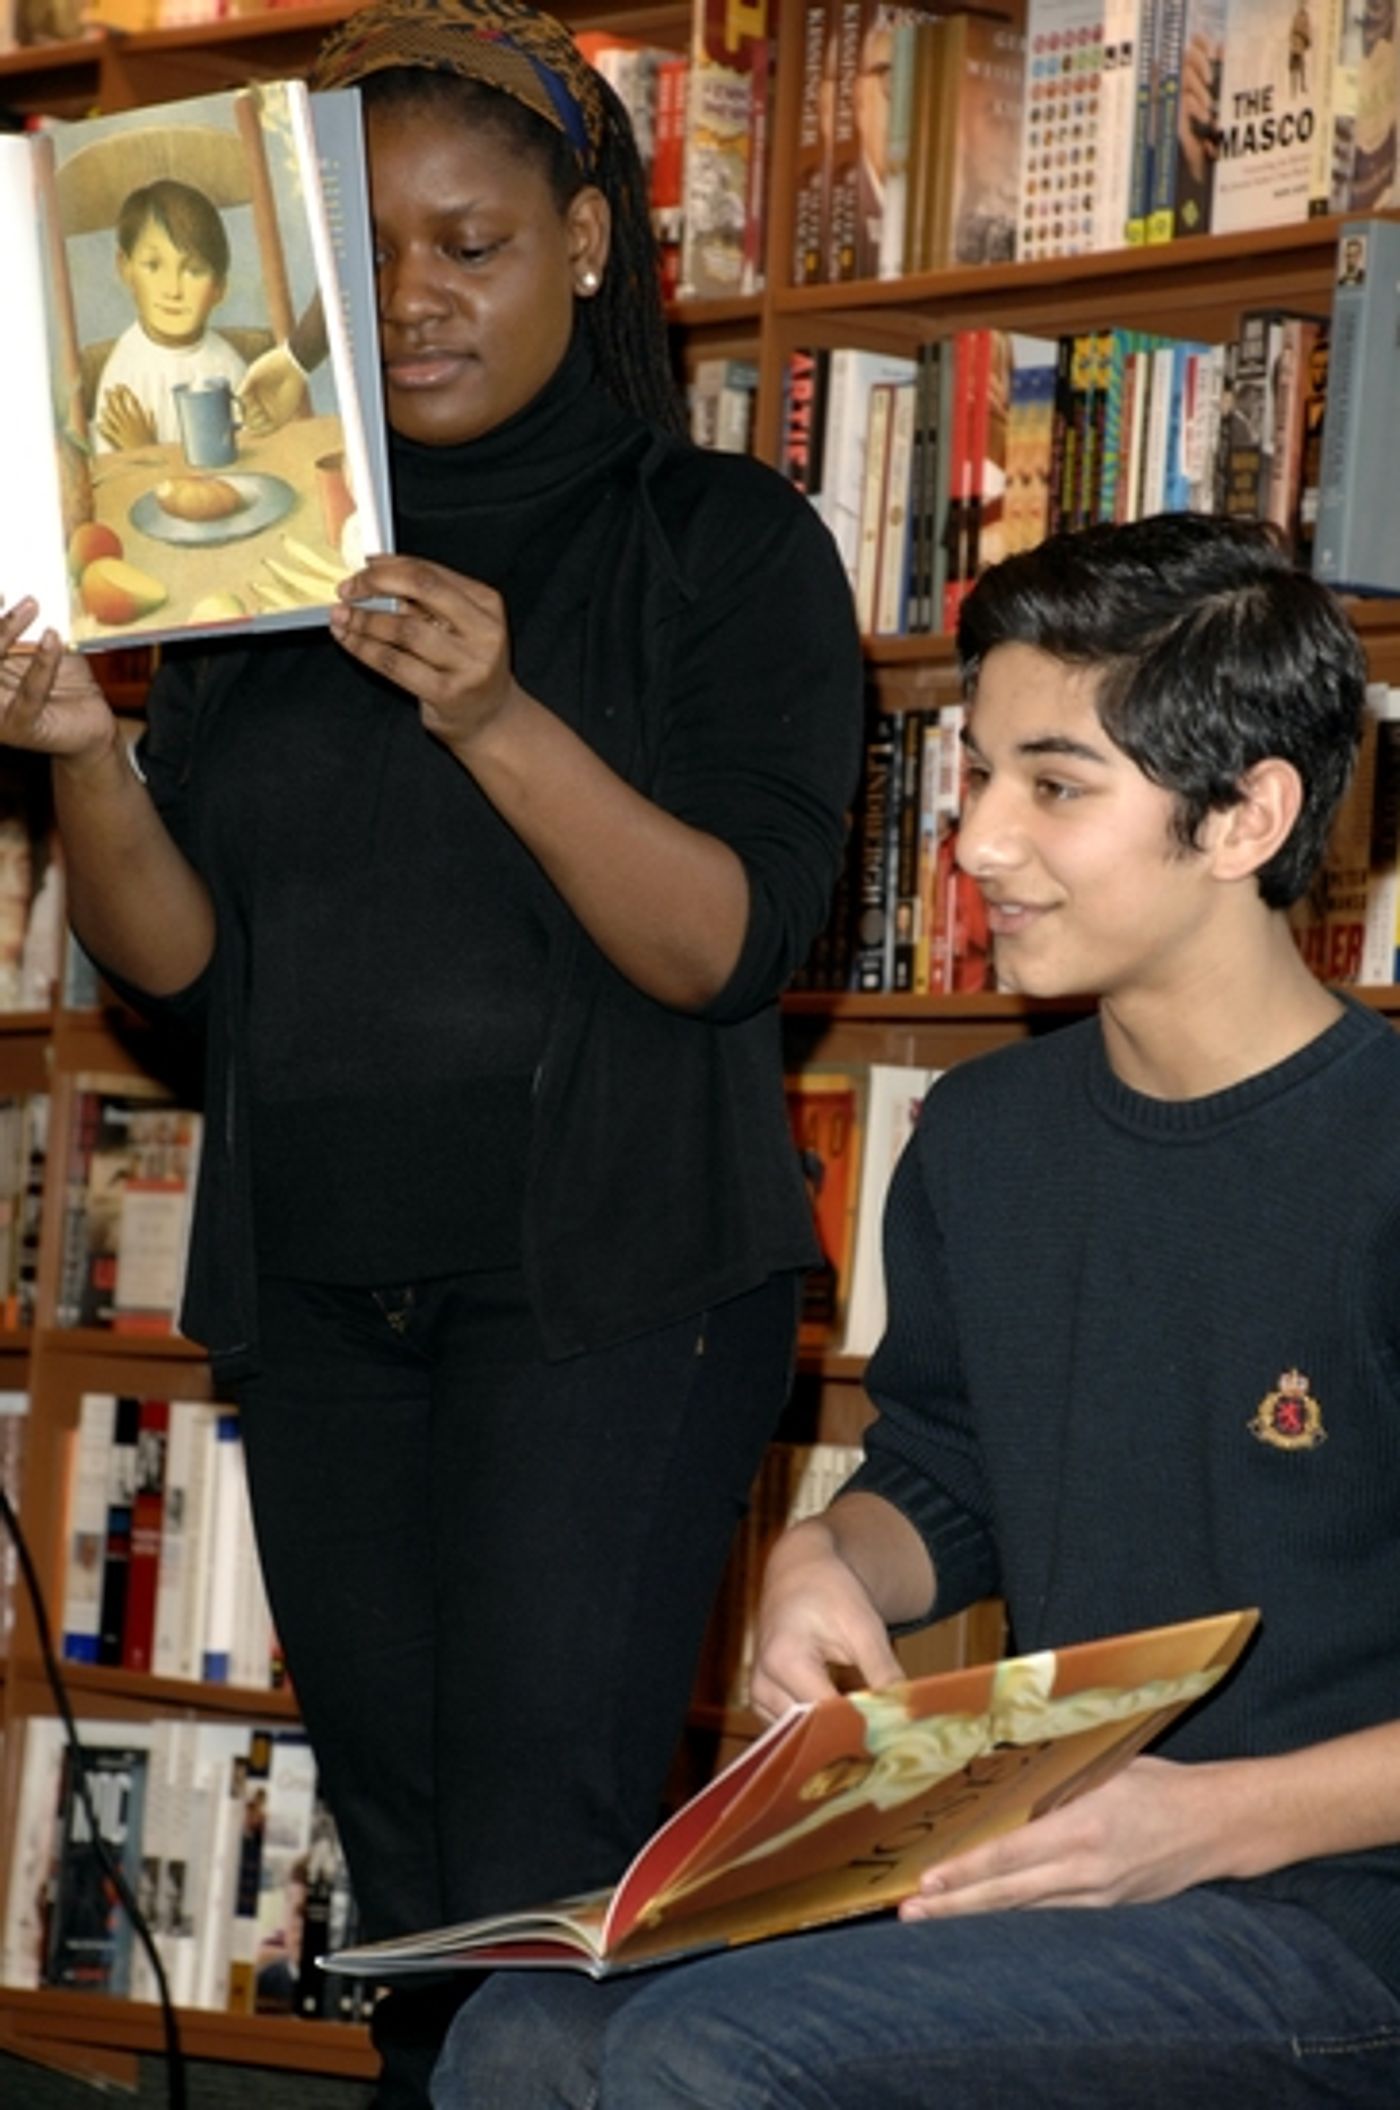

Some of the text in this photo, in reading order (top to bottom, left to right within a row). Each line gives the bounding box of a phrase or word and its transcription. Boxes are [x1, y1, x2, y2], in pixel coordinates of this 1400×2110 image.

[800, 7, 826, 148] KISSINGER
[836, 3, 861, 143] KISSINGER
[1217, 107, 1315, 160] MASCO
[1232, 84, 1275, 120] THE
[866, 743, 894, 904] LINDBERGH
